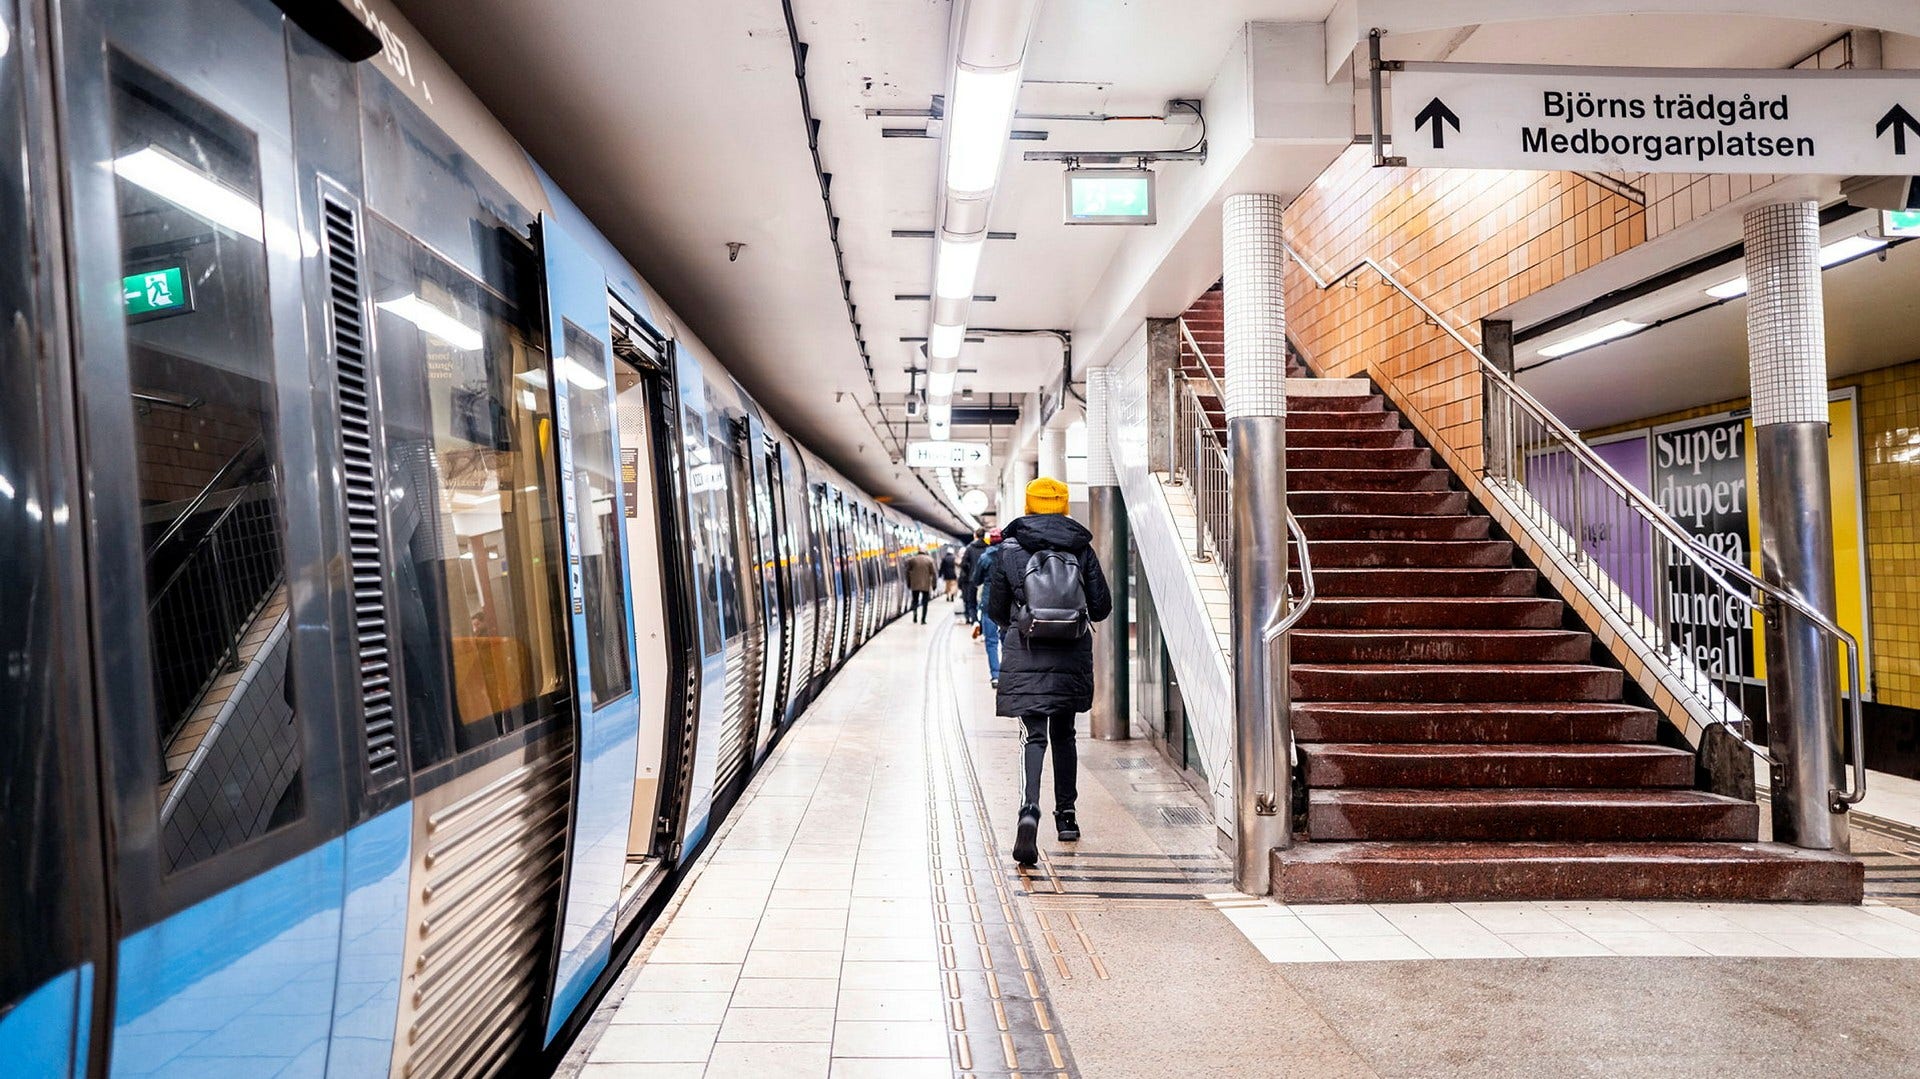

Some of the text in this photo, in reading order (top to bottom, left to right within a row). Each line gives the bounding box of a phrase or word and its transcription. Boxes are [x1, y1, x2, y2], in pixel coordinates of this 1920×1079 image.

[1543, 91, 1789, 126] Björns trädgård
[1521, 127, 1815, 161] Medborgarplatsen
[1657, 424, 1743, 475] Super
[1659, 475, 1745, 528] duper
[1669, 581, 1754, 629] under
